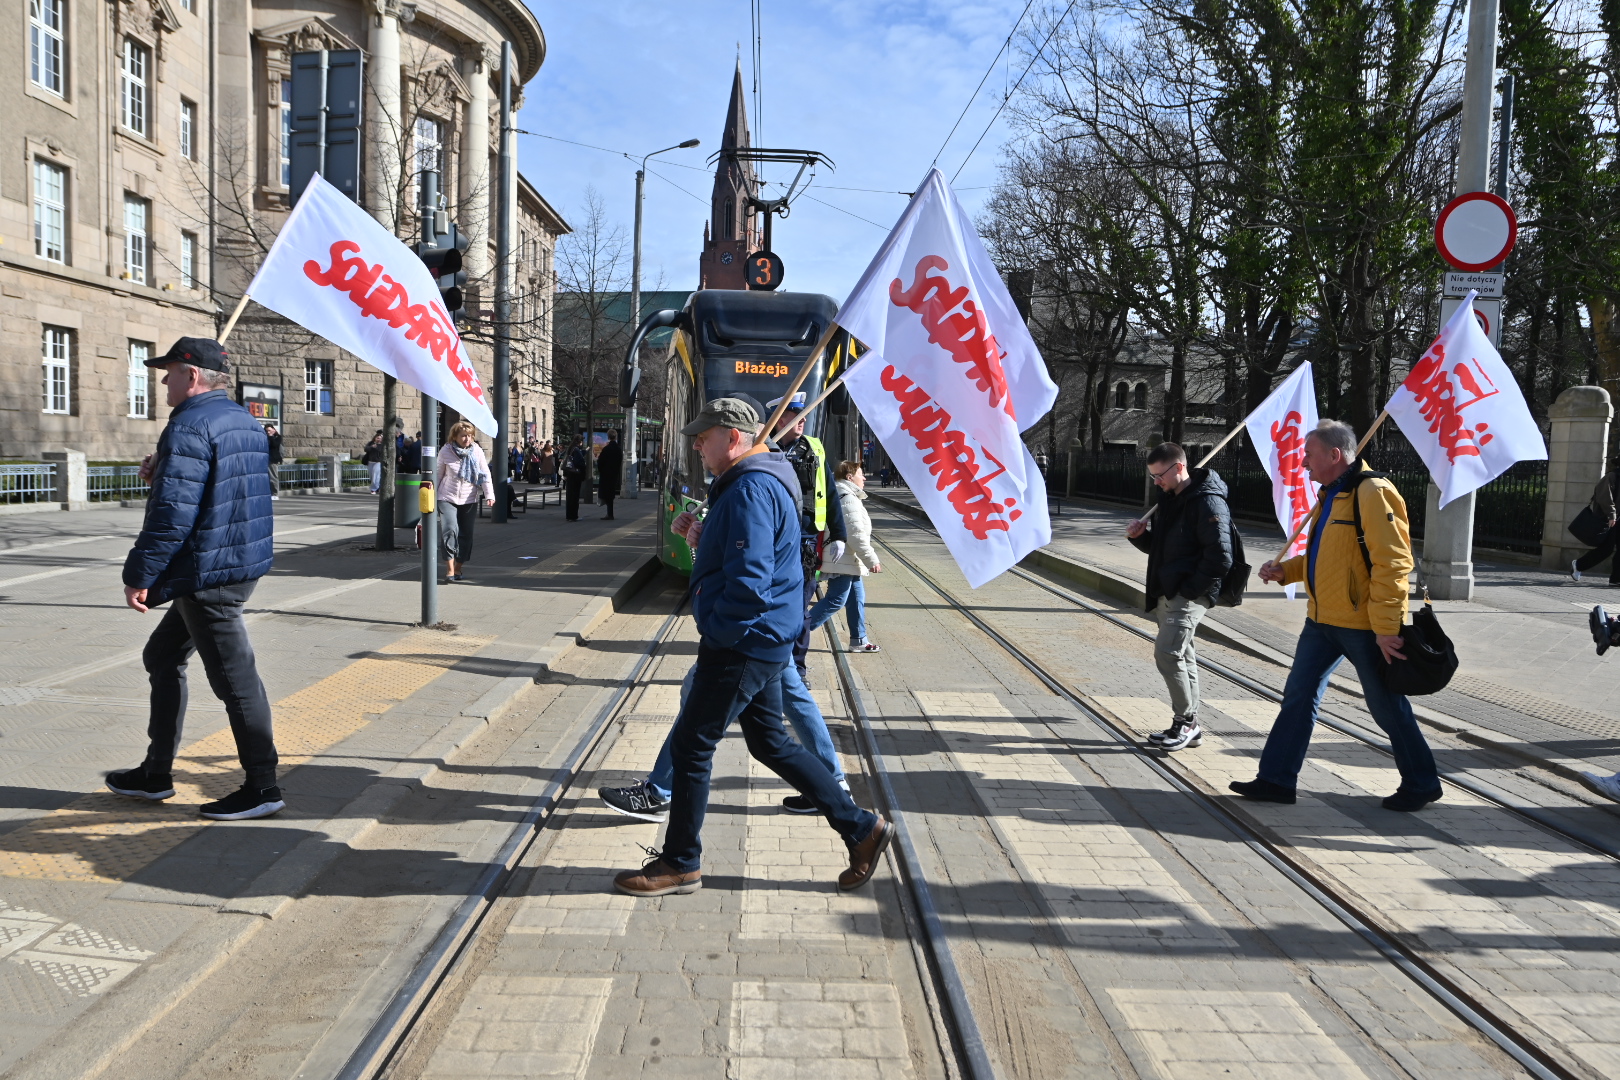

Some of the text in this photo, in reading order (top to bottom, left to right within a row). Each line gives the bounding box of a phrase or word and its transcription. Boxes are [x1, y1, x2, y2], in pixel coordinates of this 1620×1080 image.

[756, 258, 772, 285] 3
[1450, 274, 1497, 284] Nie dotyczy
[735, 361, 789, 378] Błażeja
